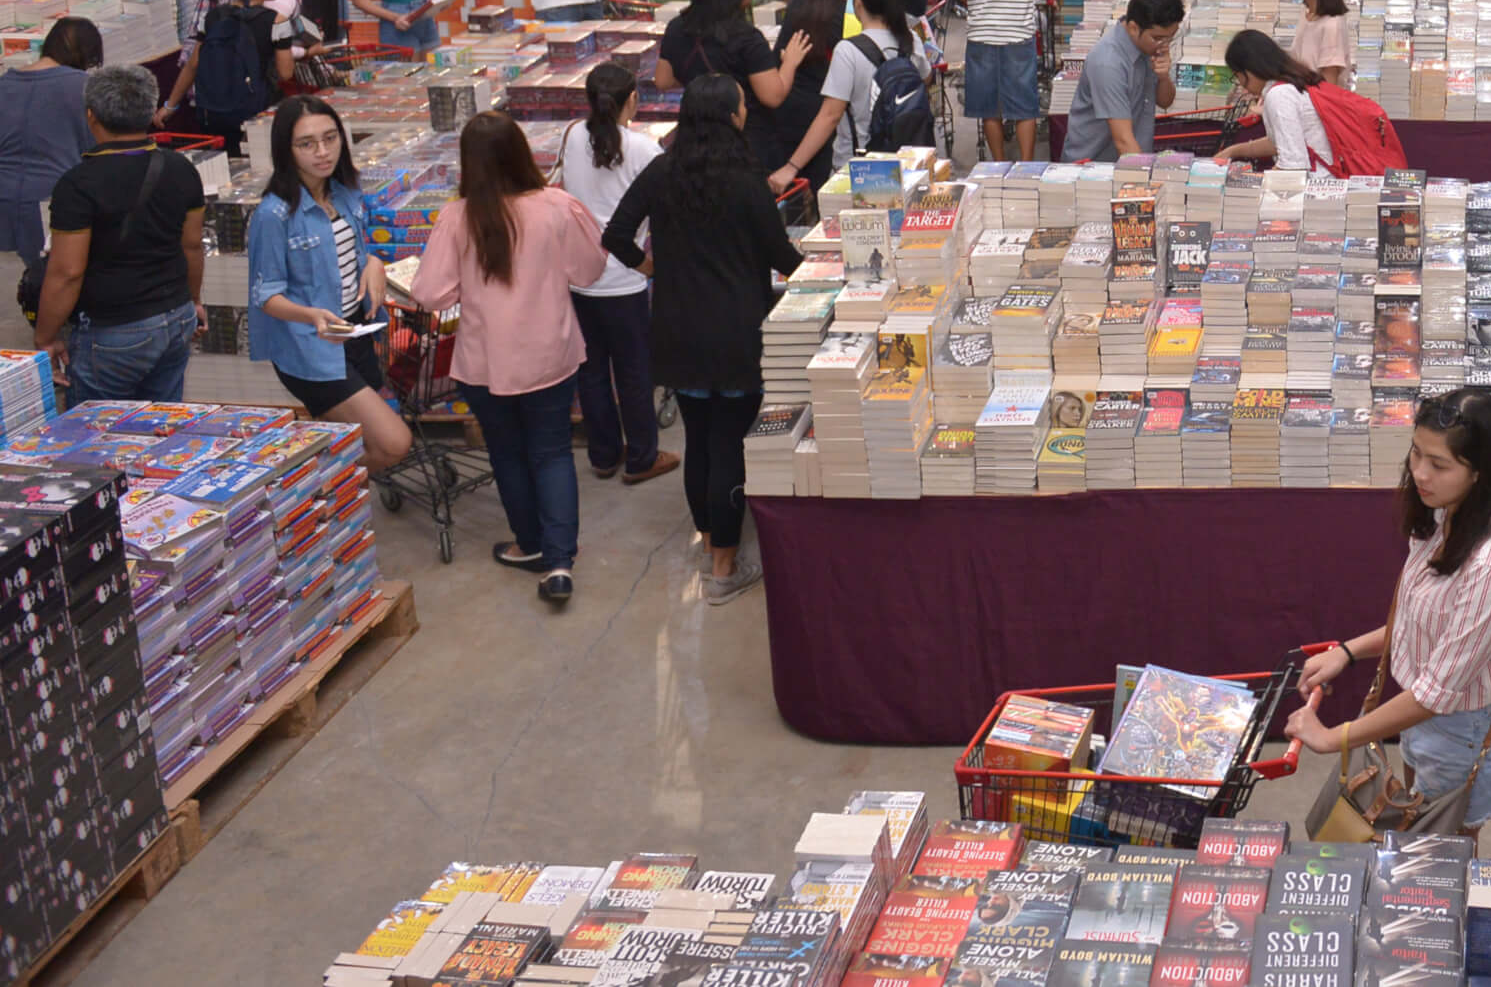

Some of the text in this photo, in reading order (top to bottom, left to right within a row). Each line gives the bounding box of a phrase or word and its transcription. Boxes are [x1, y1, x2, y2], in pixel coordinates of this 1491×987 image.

[905, 216, 954, 227] TARGET
[1115, 236, 1152, 250] LEGACY
[1172, 249, 1207, 265] JACK
[1001, 298, 1050, 307] GATES
[953, 840, 985, 851] KILLER
[1035, 843, 1102, 858] ALONE
[1204, 842, 1277, 855] ABDUCTION
[924, 848, 1006, 860] SLEEPING BEAUTY
[1028, 852, 1081, 866] MYSELF,
[1118, 854, 1148, 864] BOYD
[646, 865, 689, 875] ROOM
[995, 870, 1066, 883] ALONE
[1086, 871, 1173, 883] WILLIAM BOYD
[621, 871, 685, 884] BURNING
[695, 876, 766, 893] TUROW
[1283, 871, 1352, 892] CLASS
[988, 880, 1046, 893] MYSELF,
[915, 897, 949, 908] KILLER
[1018, 892, 1035, 901] BY
[1181, 892, 1260, 905] ABDUCTION
[1281, 892, 1349, 906] DIFFERENT
[753, 911, 834, 926] KILLER
[885, 905, 971, 921] SLEEPING BEAUTY
[748, 923, 831, 935] CRUCIFIX
[884, 928, 954, 943] CLARK
[975, 924, 1050, 937] CLARK
[461, 938, 529, 959] LEGACY
[870, 939, 958, 956] HIGGINS
[1267, 931, 1340, 952] CLASS
[966, 942, 1043, 959] ALONE
[1059, 949, 1152, 965] WILLIAM BOYD
[1391, 948, 1428, 962] Traitor
[959, 955, 1021, 969] MYSELF,
[1265, 953, 1339, 967] DIFFERENT
[706, 966, 792, 984] KILLER
[991, 968, 1040, 979] ALL BY
[1160, 966, 1244, 980] ABDUCTION
[1264, 973, 1337, 987] HARRIS
